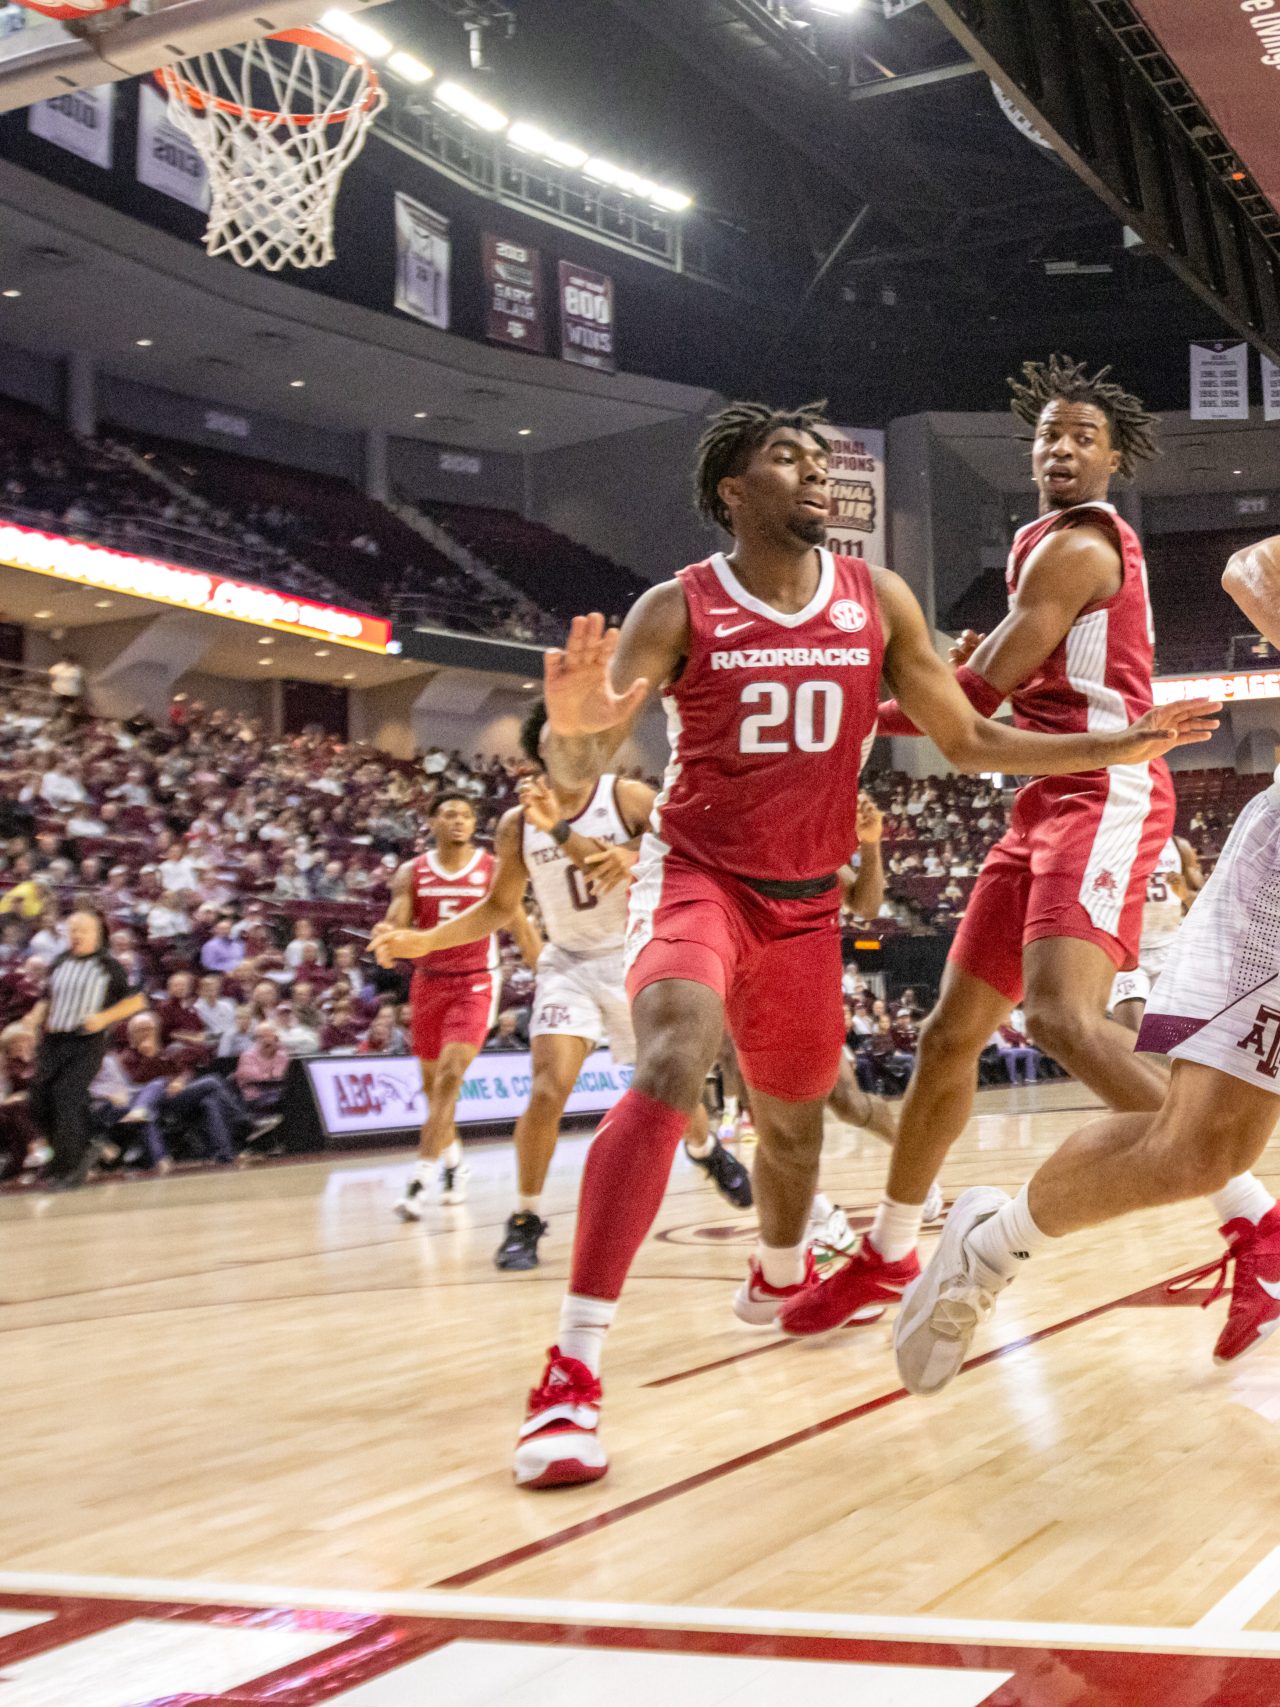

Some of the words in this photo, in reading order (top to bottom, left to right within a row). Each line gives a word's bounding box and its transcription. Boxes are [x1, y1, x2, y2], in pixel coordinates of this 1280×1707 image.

[564, 286, 611, 324] 800
[567, 322, 612, 353] WINS
[710, 647, 871, 671] RAZORBACKS
[739, 680, 844, 753] 20
[493, 1076, 508, 1098] &
